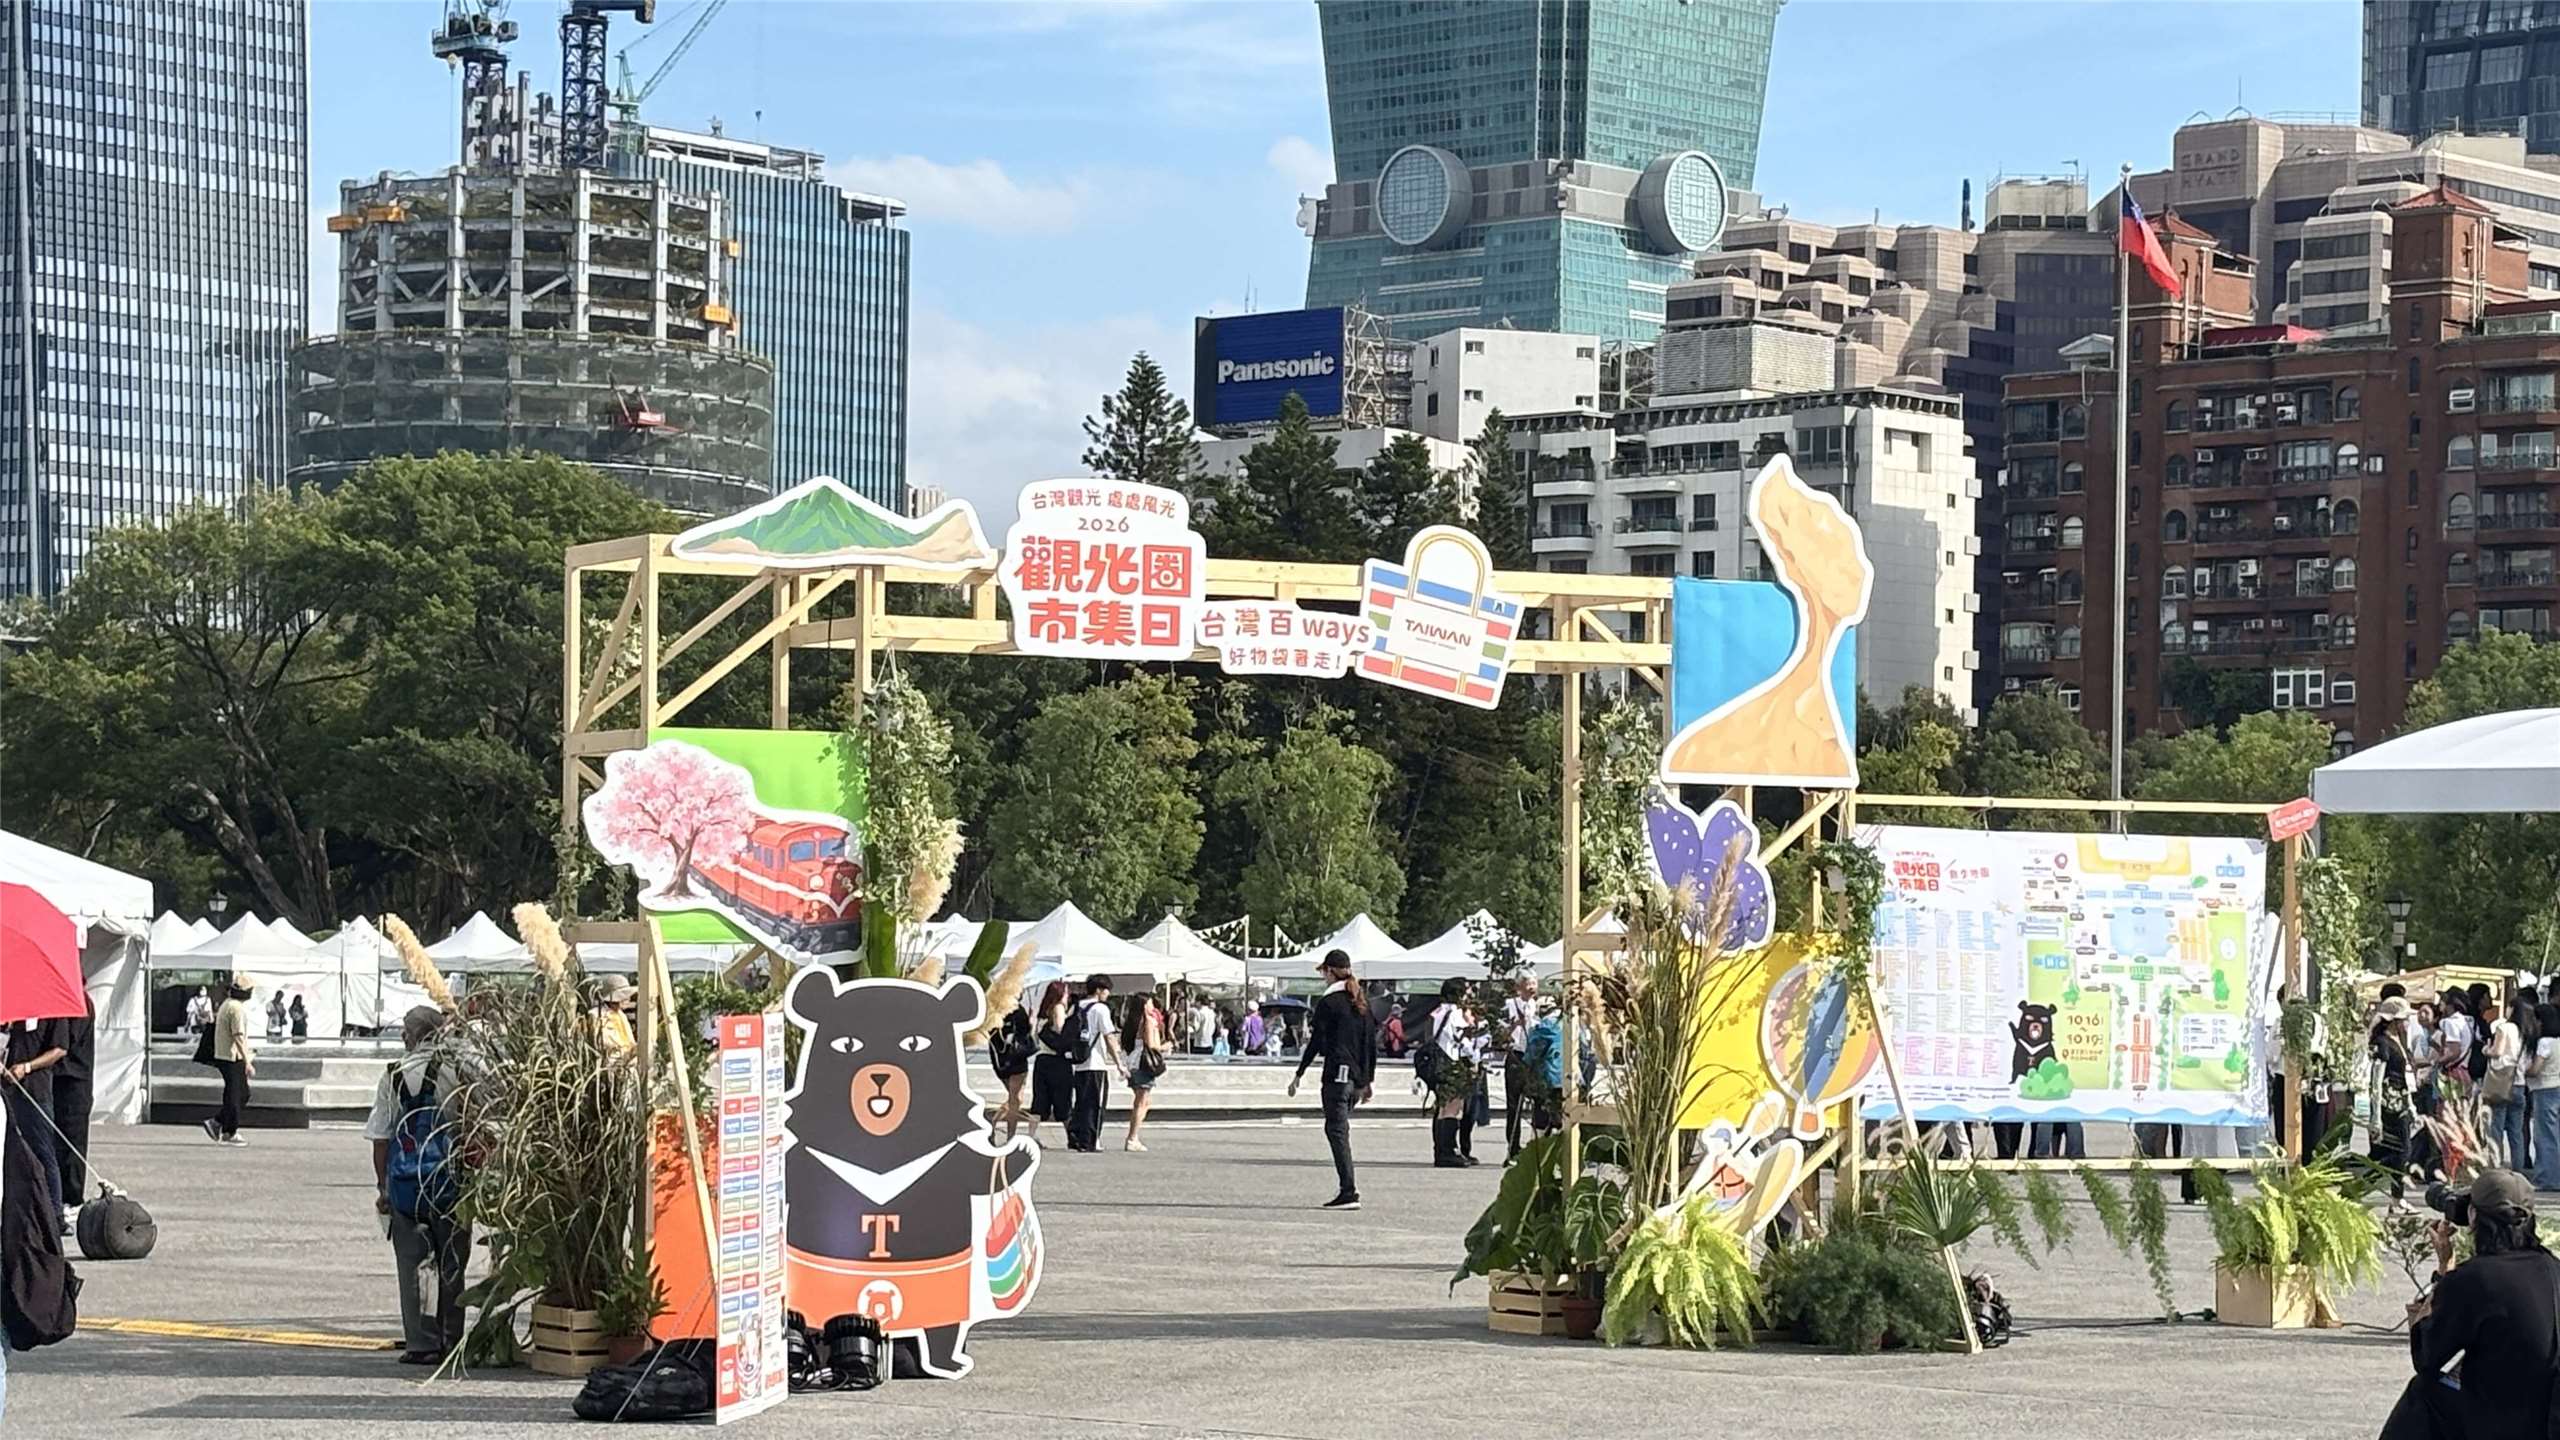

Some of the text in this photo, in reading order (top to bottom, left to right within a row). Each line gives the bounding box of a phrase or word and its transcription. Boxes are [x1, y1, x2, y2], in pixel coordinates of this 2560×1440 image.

[2181, 148, 2241, 167] GRAND
[2181, 169, 2239, 189] HYATT
[1217, 350, 1335, 384] Panasonic
[1032, 488, 1176, 519] 台灣觀光 處處風光
[1077, 516, 1130, 533] 2026
[1013, 535, 1193, 598] 觀光圈
[1028, 597, 1181, 647] 市集日
[1201, 608, 1371, 647] 台灣百 ways
[1405, 618, 1472, 647] TAIWAN
[861, 1214, 900, 1259] T
